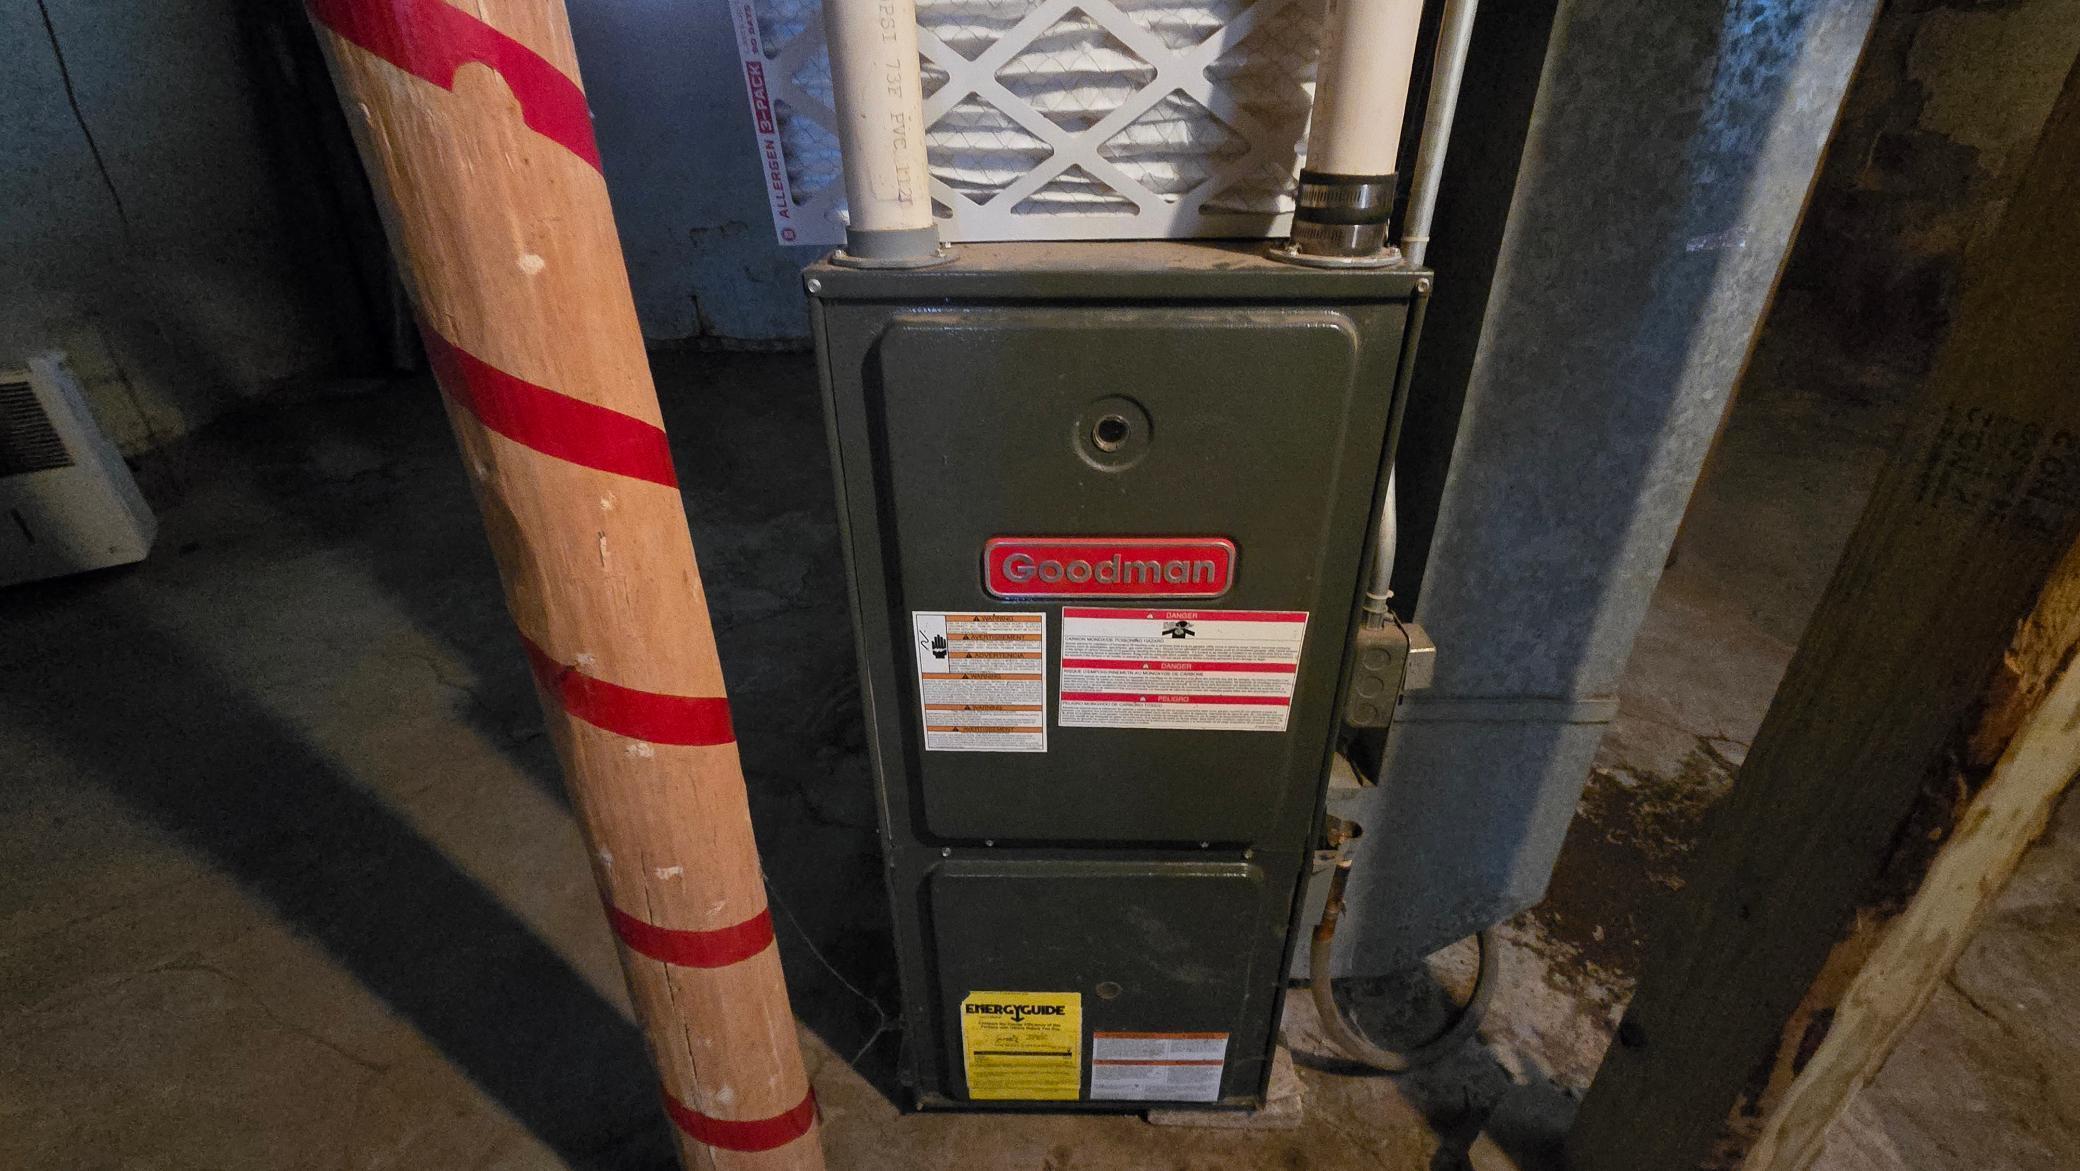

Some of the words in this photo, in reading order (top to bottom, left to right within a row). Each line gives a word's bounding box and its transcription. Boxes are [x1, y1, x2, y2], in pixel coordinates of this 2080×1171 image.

[743, 4, 755, 34] DAYS
[748, 62, 772, 131] 3-PACK
[880, 0, 896, 40] PSI
[890, 112, 907, 149] PVC
[765, 140, 790, 218] ALLERGEN
[1002, 553, 1216, 584] Goodman
[965, 1004, 1066, 1020] ENERGYGUIDE
